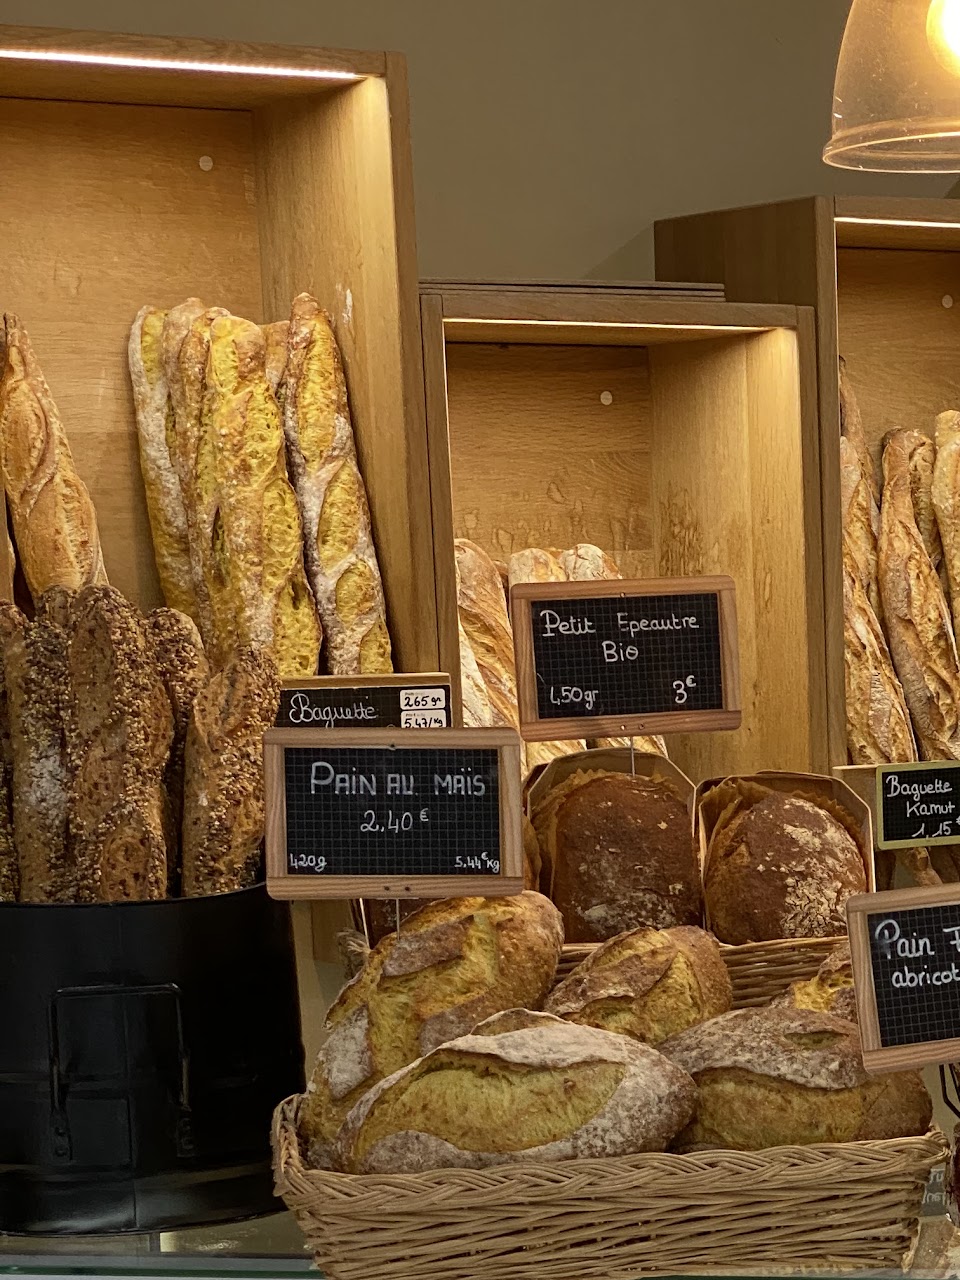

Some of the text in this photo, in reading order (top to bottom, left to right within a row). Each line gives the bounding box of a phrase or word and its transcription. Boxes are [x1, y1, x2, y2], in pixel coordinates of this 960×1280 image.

[540, 610, 700, 638] Petit Epeautre
[602, 641, 639, 663] Bio
[289, 692, 379, 728] Baguette
[404, 695, 430, 707] 265
[886, 775, 953, 802] Baguette
[906, 801, 956, 817] Kamut
[290, 853, 327, 872] 420g
[875, 918, 935, 960] Pain
[891, 962, 960, 988] abricot
